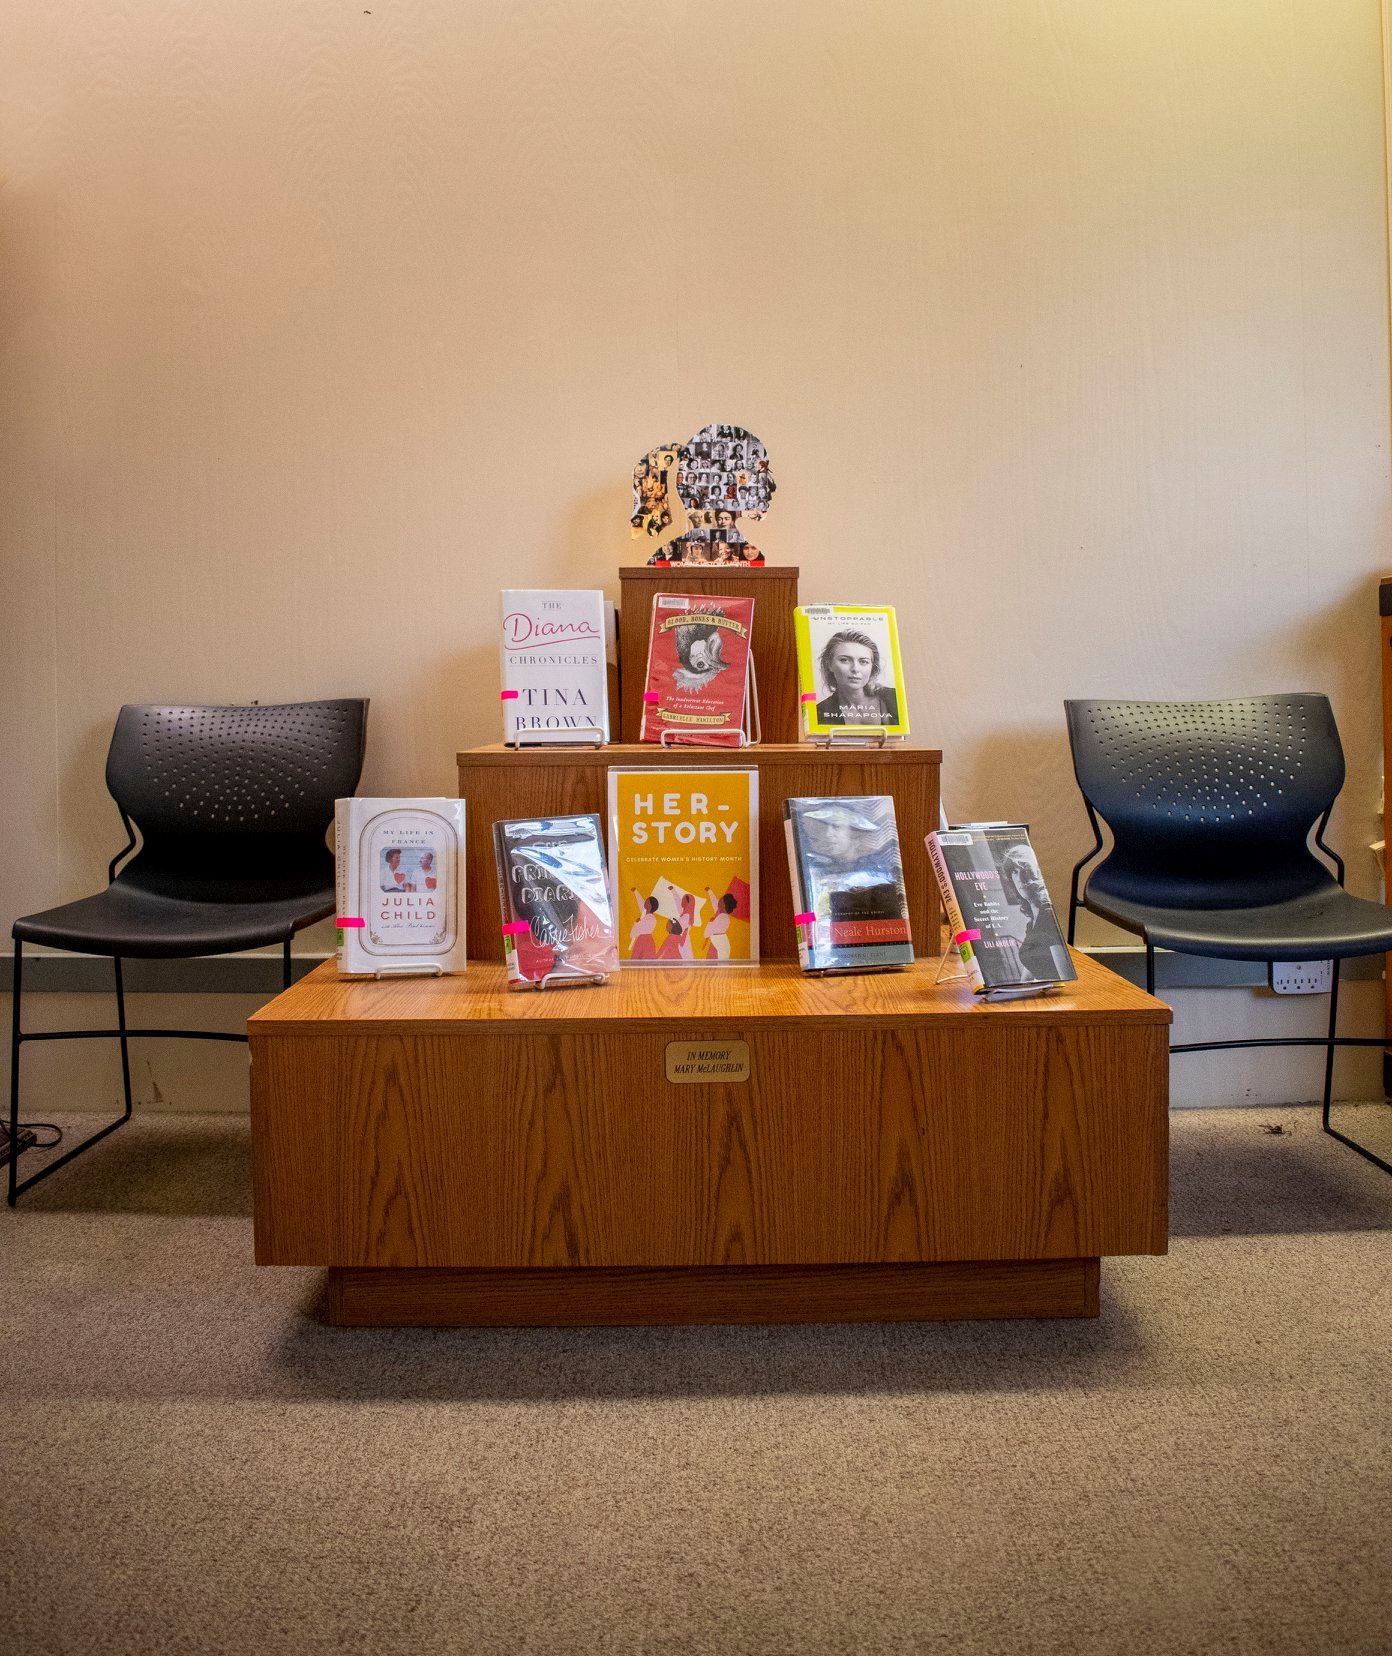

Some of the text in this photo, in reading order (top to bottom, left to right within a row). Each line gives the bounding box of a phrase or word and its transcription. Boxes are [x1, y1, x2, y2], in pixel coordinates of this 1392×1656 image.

[502, 613, 599, 643] Diana
[509, 656, 598, 665] CHRONICLES
[522, 688, 588, 706] TINA
[515, 716, 597, 730] BROWN
[632, 821, 739, 844] STORY
[927, 839, 953, 904] HOLLYWOOD'S EVE
[954, 870, 1001, 881] HOLLYWOOD'S
[974, 881, 989, 891] EVE
[382, 897, 434, 906] JULIA
[380, 911, 436, 920] CHILD
[833, 926, 906, 938] Neale Hurston
[686, 1050, 732, 1060] IN MEMORY
[674, 1063, 744, 1073] MARY McLAUGHLIN
